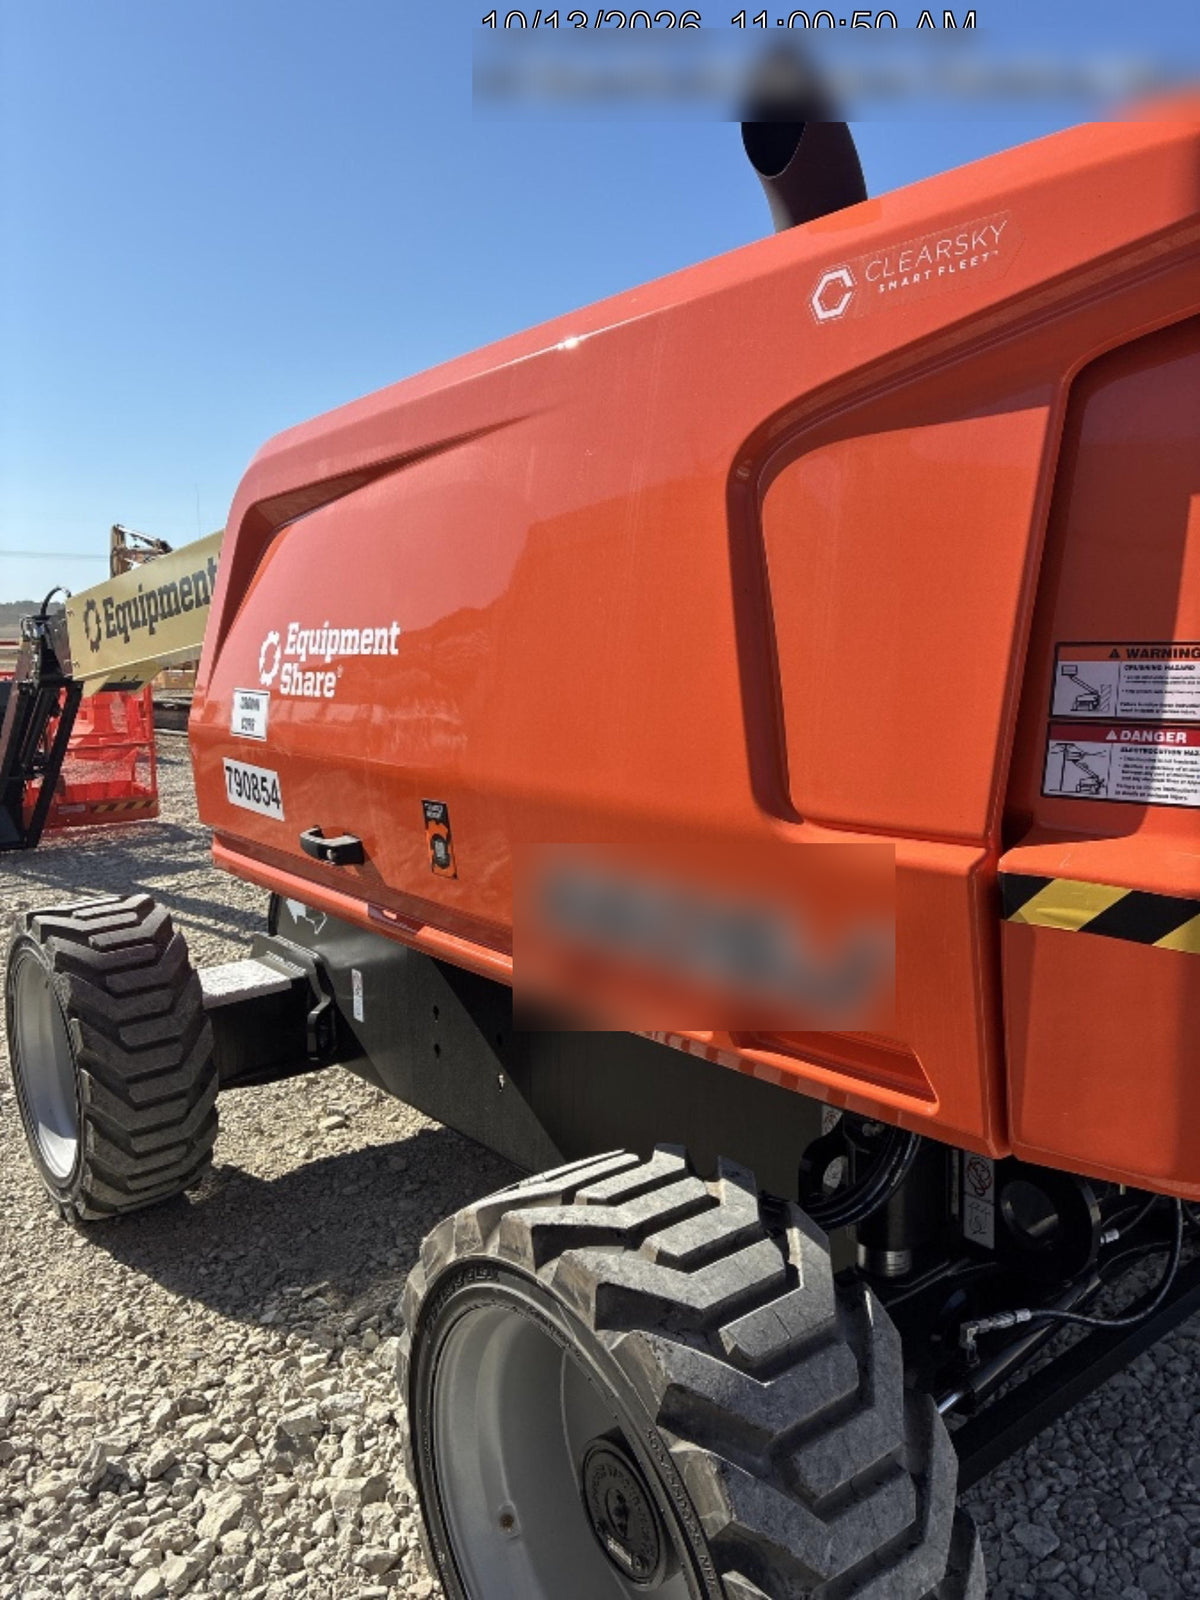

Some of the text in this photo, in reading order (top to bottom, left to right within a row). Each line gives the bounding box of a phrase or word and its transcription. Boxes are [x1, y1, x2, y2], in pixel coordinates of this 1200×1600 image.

[865, 220, 1008, 282] CLEARSKY
[877, 252, 989, 293] SMART FLEET
[103, 557, 218, 643] Equipment
[284, 620, 401, 663] Equipment
[1126, 647, 1200, 659] WARNING
[280, 662, 337, 698] Share
[1119, 729, 1188, 744] DANGER
[225, 765, 281, 809] 790854
